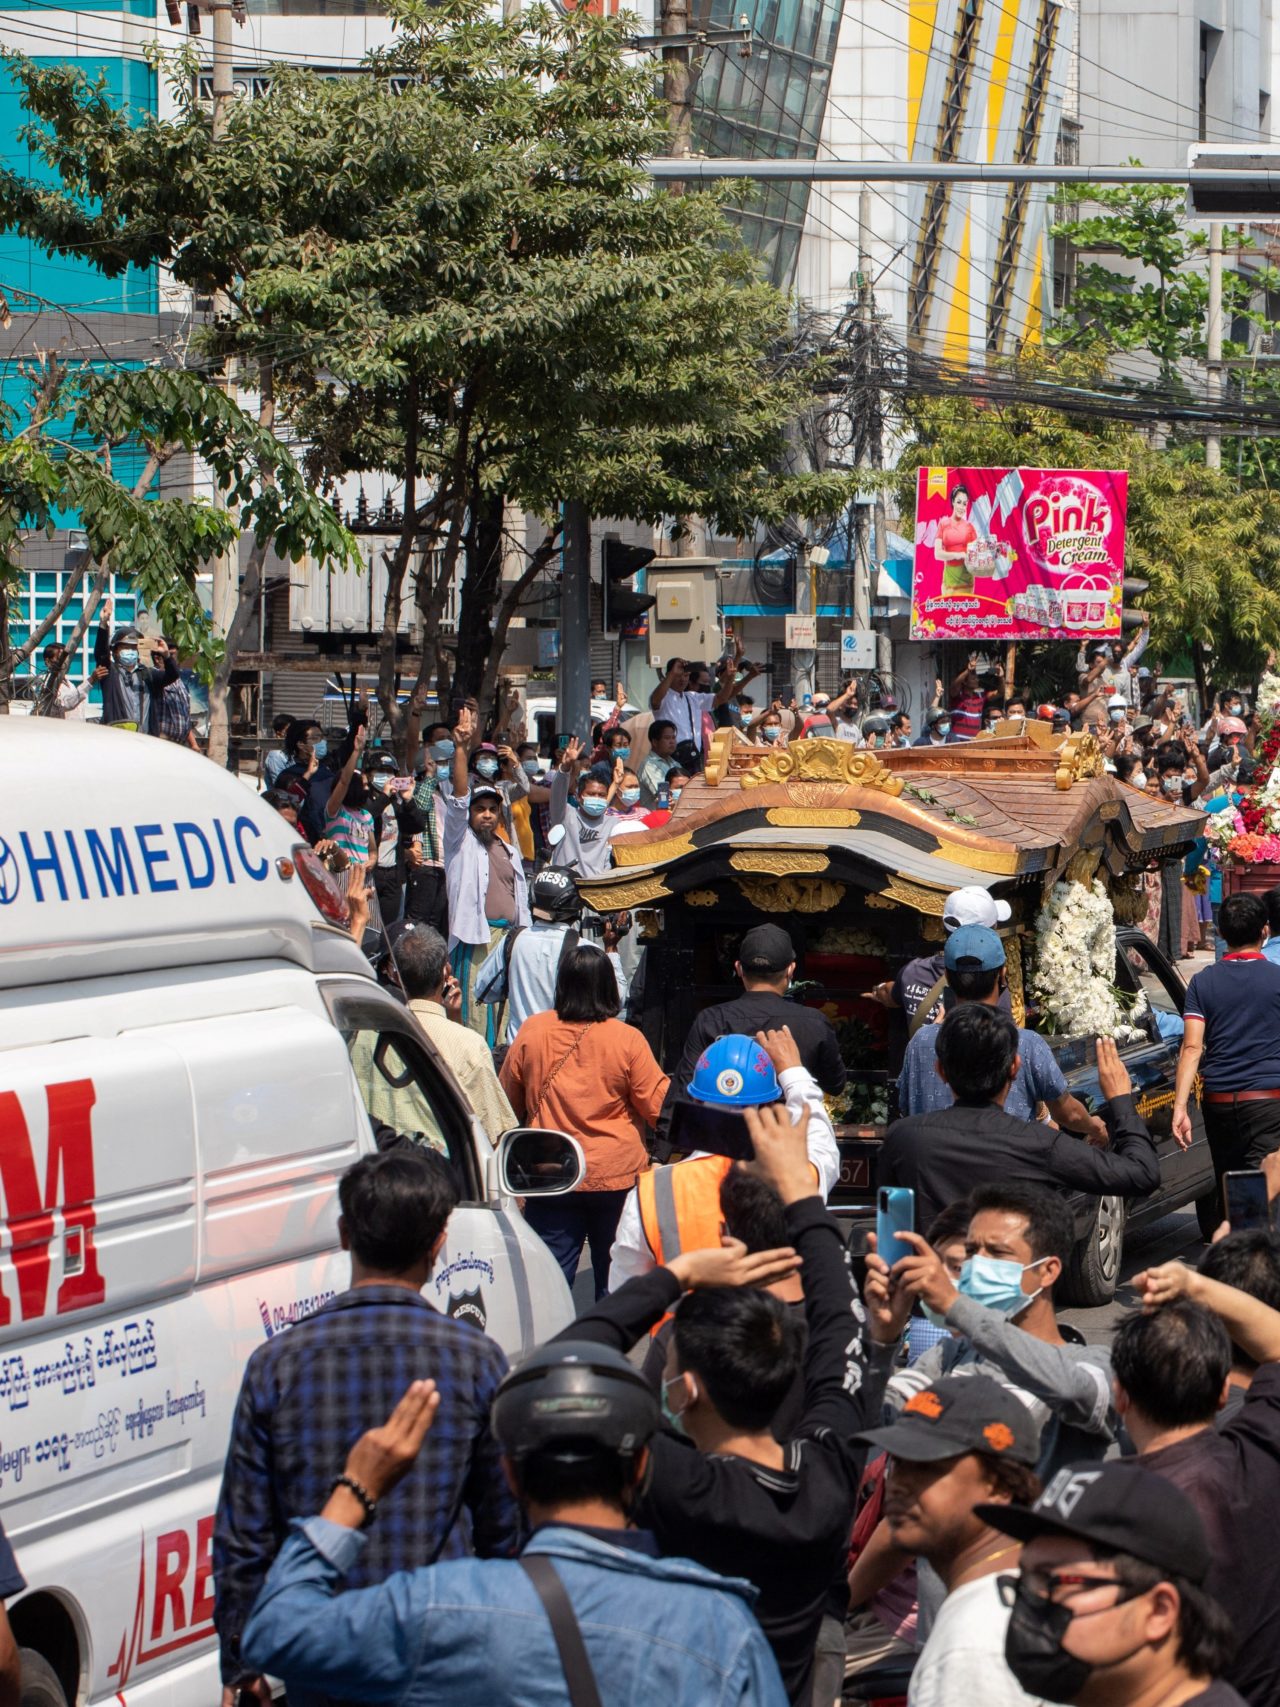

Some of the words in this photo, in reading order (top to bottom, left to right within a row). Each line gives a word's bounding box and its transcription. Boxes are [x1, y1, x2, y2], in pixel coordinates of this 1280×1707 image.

[1024, 492, 1110, 544] Pink
[1047, 536, 1103, 554] Detergent
[1061, 550, 1108, 567] Cream
[18, 814, 270, 903] HIMEDIC
[534, 870, 569, 888] PRESS
[452, 1303, 488, 1327] RESCUE
